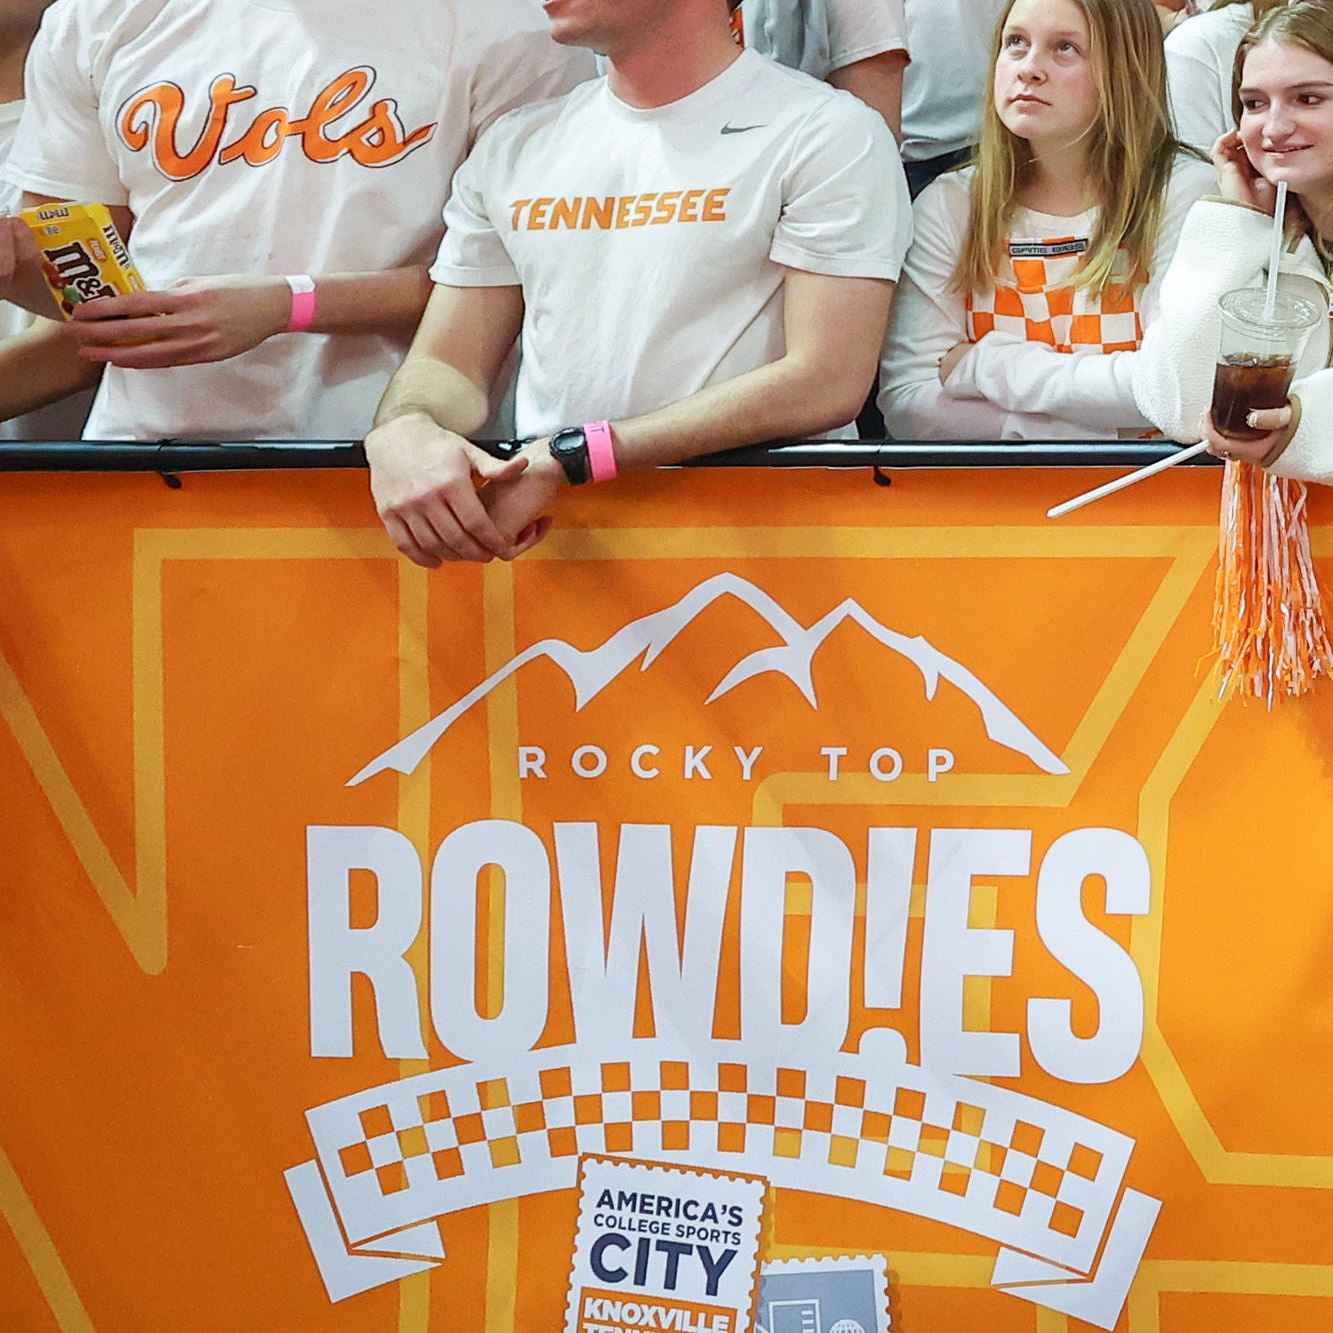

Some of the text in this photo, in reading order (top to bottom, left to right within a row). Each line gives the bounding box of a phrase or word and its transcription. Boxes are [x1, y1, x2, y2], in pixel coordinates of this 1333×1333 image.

[115, 65, 438, 182] Vols
[510, 189, 729, 231] TENNESSEE
[1051, 243, 1084, 253] BIBS
[518, 744, 957, 783] ROCKY TOP
[595, 1188, 744, 1229] AMERICA'S
[593, 1213, 742, 1246] COLLEGE SPORTS
[589, 1232, 738, 1298] CITY
[584, 1297, 731, 1333] KNOXVILLE
